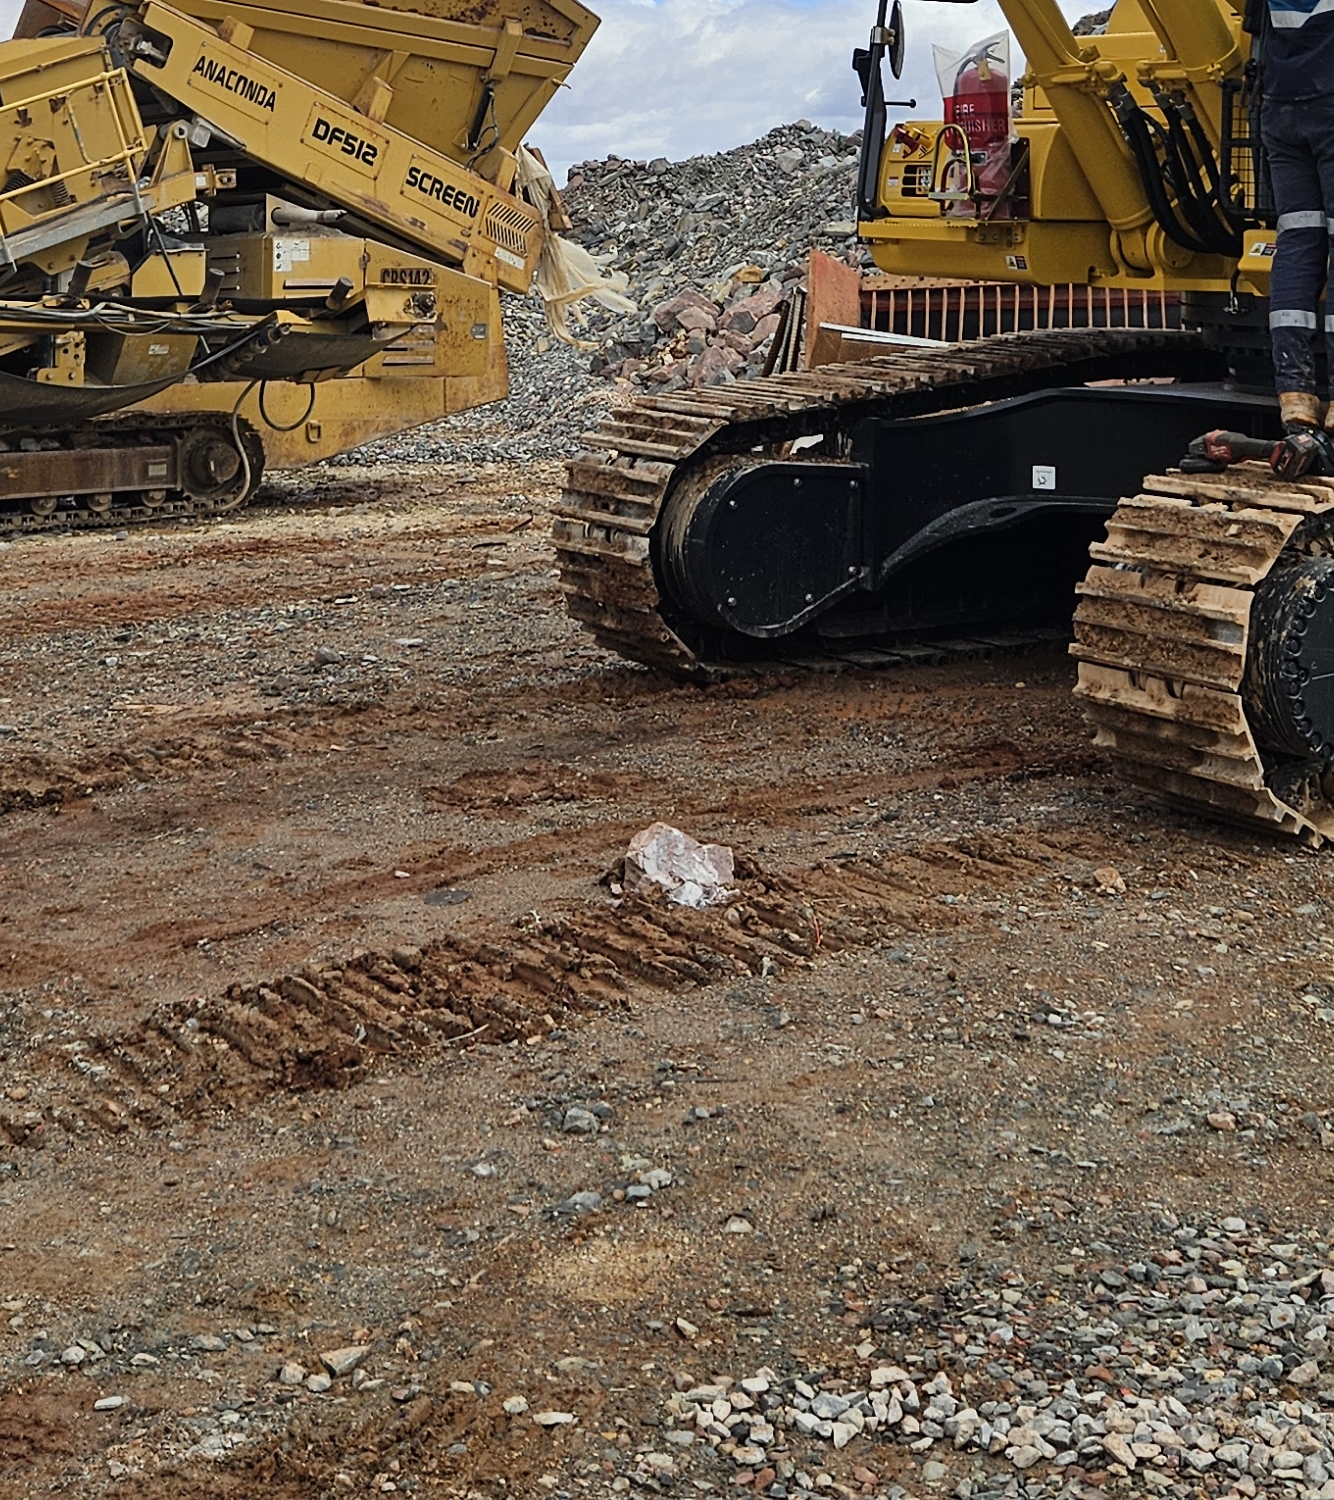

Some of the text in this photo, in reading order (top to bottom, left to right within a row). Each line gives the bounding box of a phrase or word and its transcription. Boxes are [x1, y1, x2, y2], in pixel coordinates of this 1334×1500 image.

[192, 54, 278, 113] ANACONDA
[311, 116, 378, 167] DF512
[405, 165, 481, 219] SCREEN
